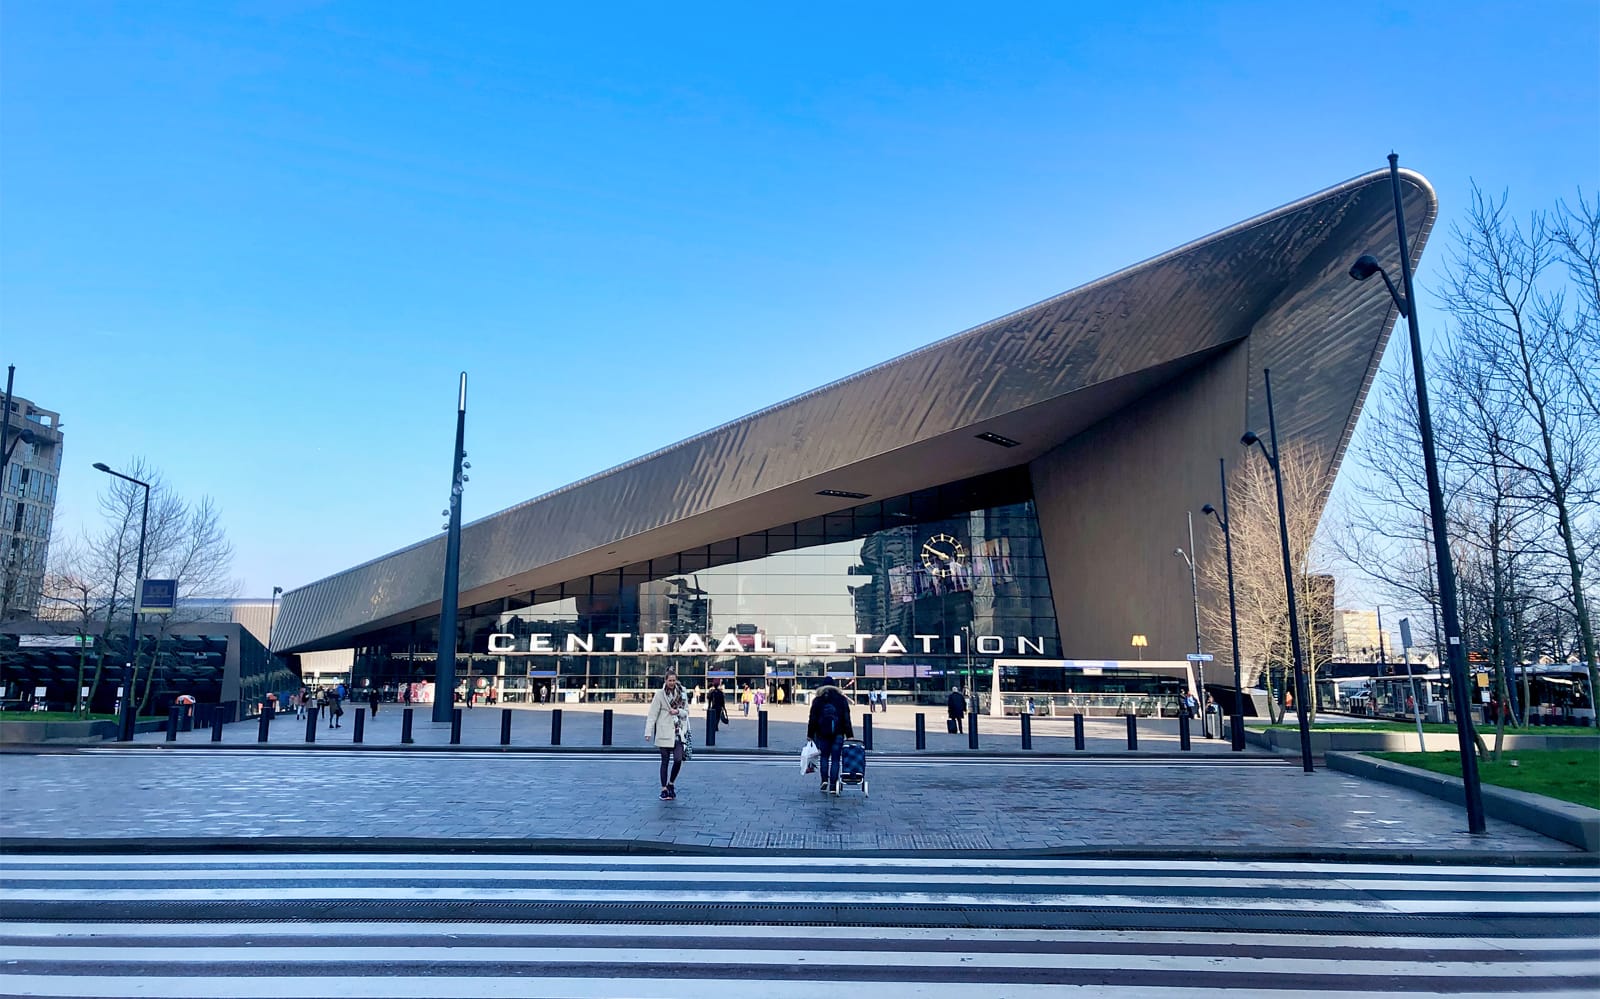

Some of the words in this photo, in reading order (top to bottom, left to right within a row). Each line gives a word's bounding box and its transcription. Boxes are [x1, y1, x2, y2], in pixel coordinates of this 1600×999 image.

[488, 633, 774, 652] CENTRAAL
[810, 634, 1044, 655] STATION
[1131, 635, 1148, 647] M
